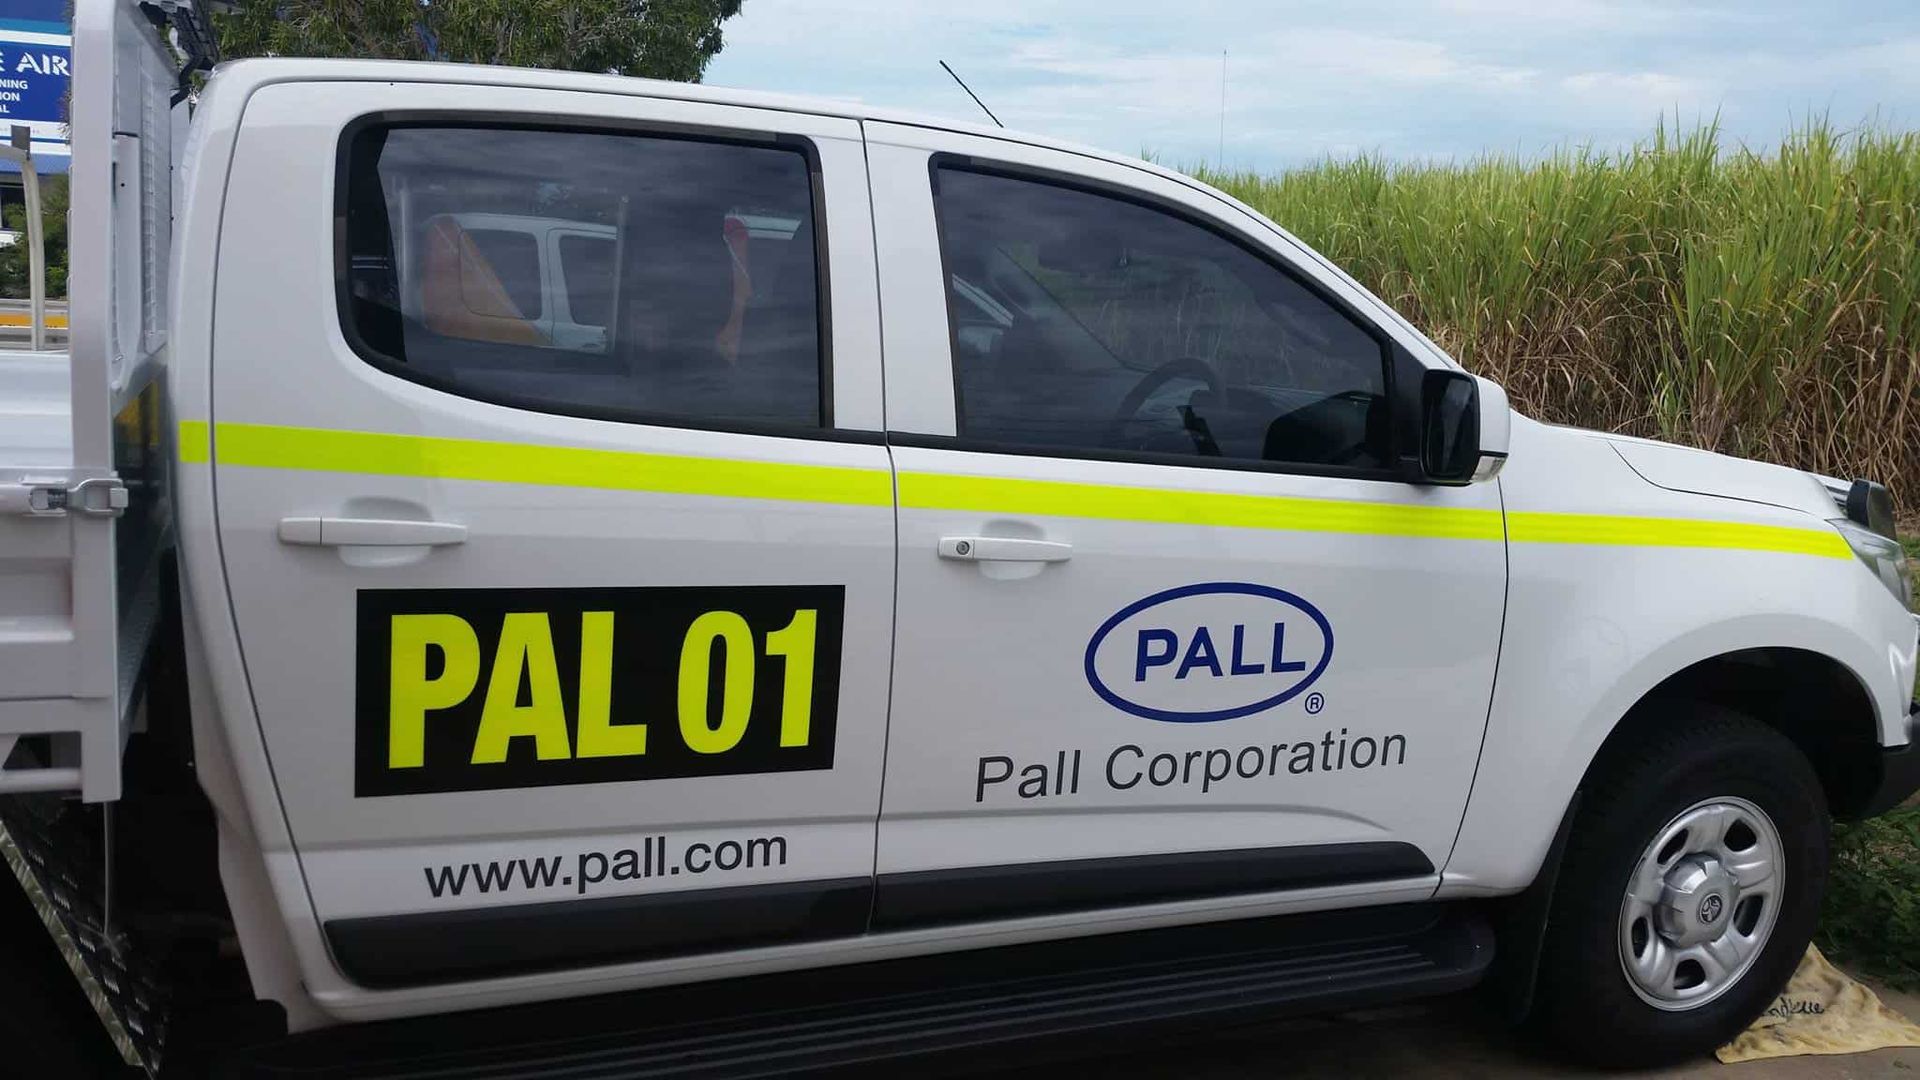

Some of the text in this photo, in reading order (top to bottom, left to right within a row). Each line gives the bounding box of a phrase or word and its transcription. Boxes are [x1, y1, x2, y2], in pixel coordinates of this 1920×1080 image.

[16, 52, 71, 76] AIR
[1135, 622, 1306, 682] PALL
[389, 608, 818, 768] PAL 01
[976, 728, 1407, 802] Pall Corporation
[424, 836, 787, 898] www.pall.com
